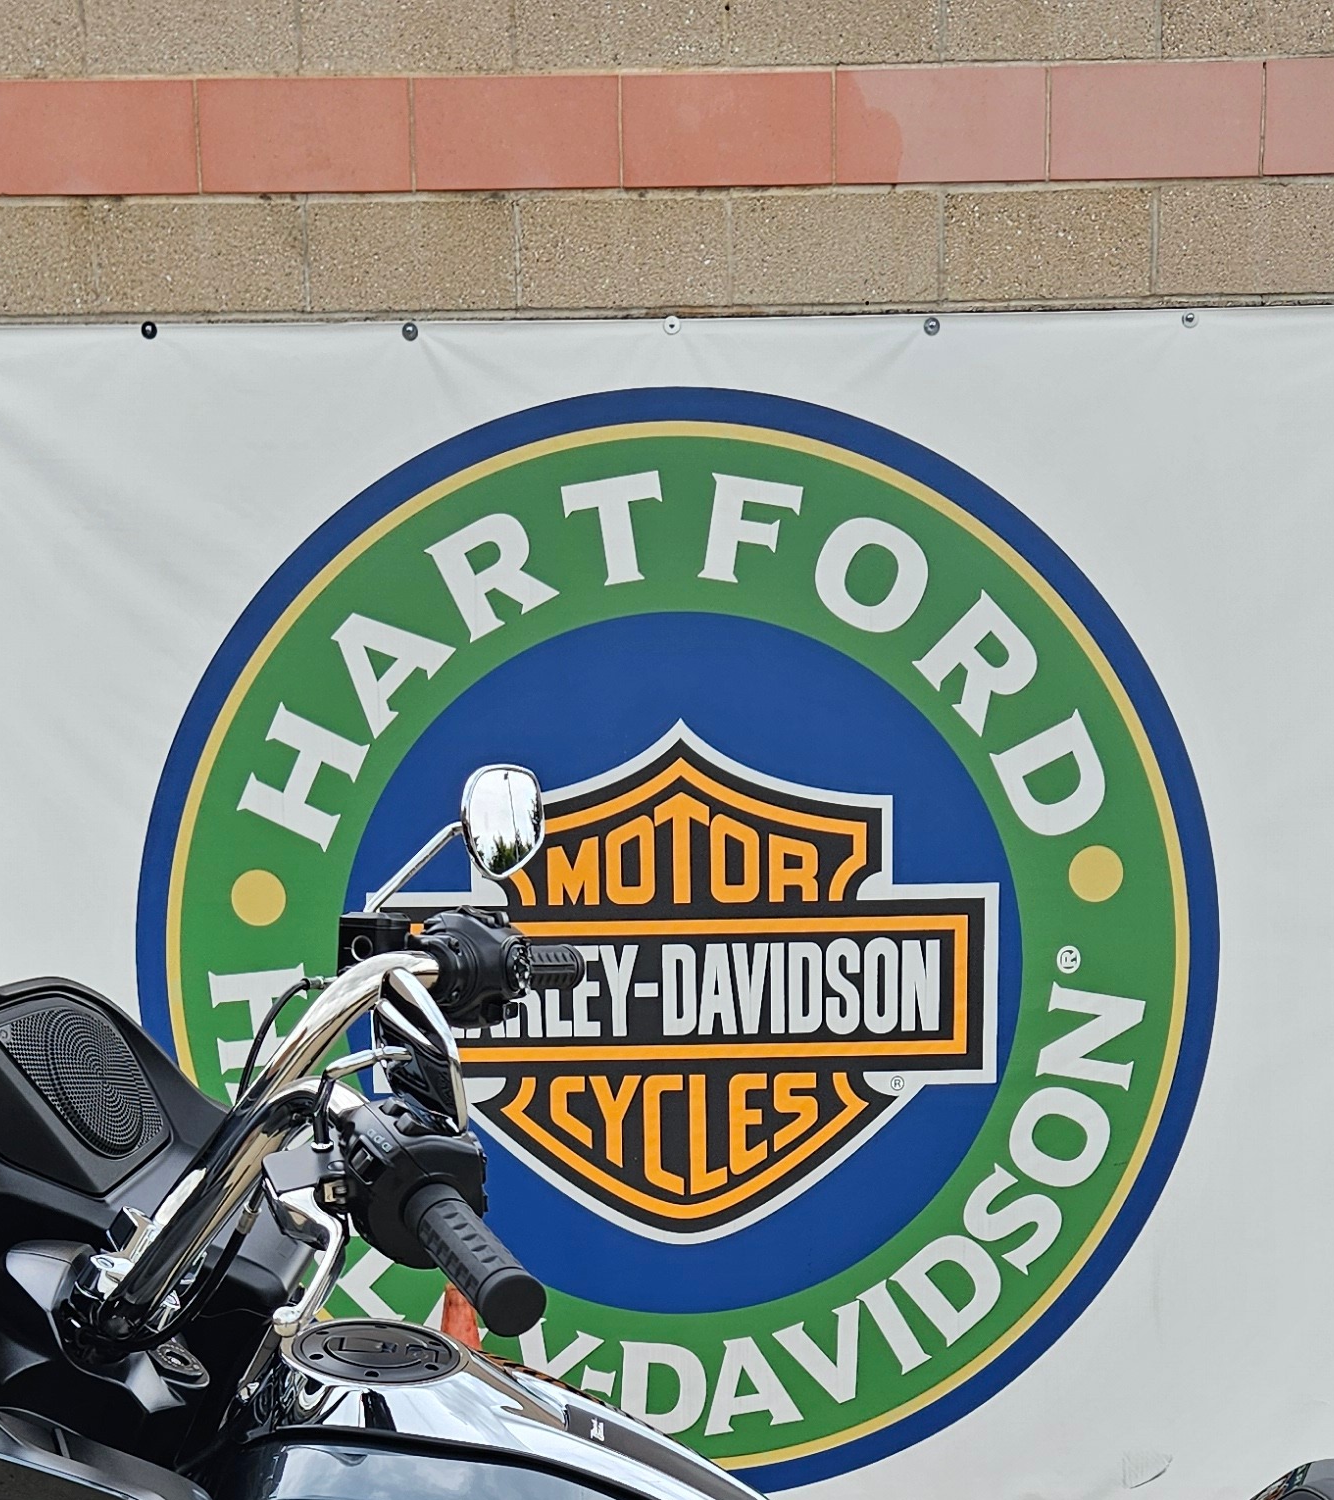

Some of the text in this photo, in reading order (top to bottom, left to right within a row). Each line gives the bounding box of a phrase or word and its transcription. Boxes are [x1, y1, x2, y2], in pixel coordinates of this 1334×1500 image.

[236, 470, 1106, 853] HARTFORD
[547, 792, 819, 905] MOTOR
[451, 936, 941, 1039] LEY-DAVIDSON
[550, 1072, 819, 1195] CYCLES
